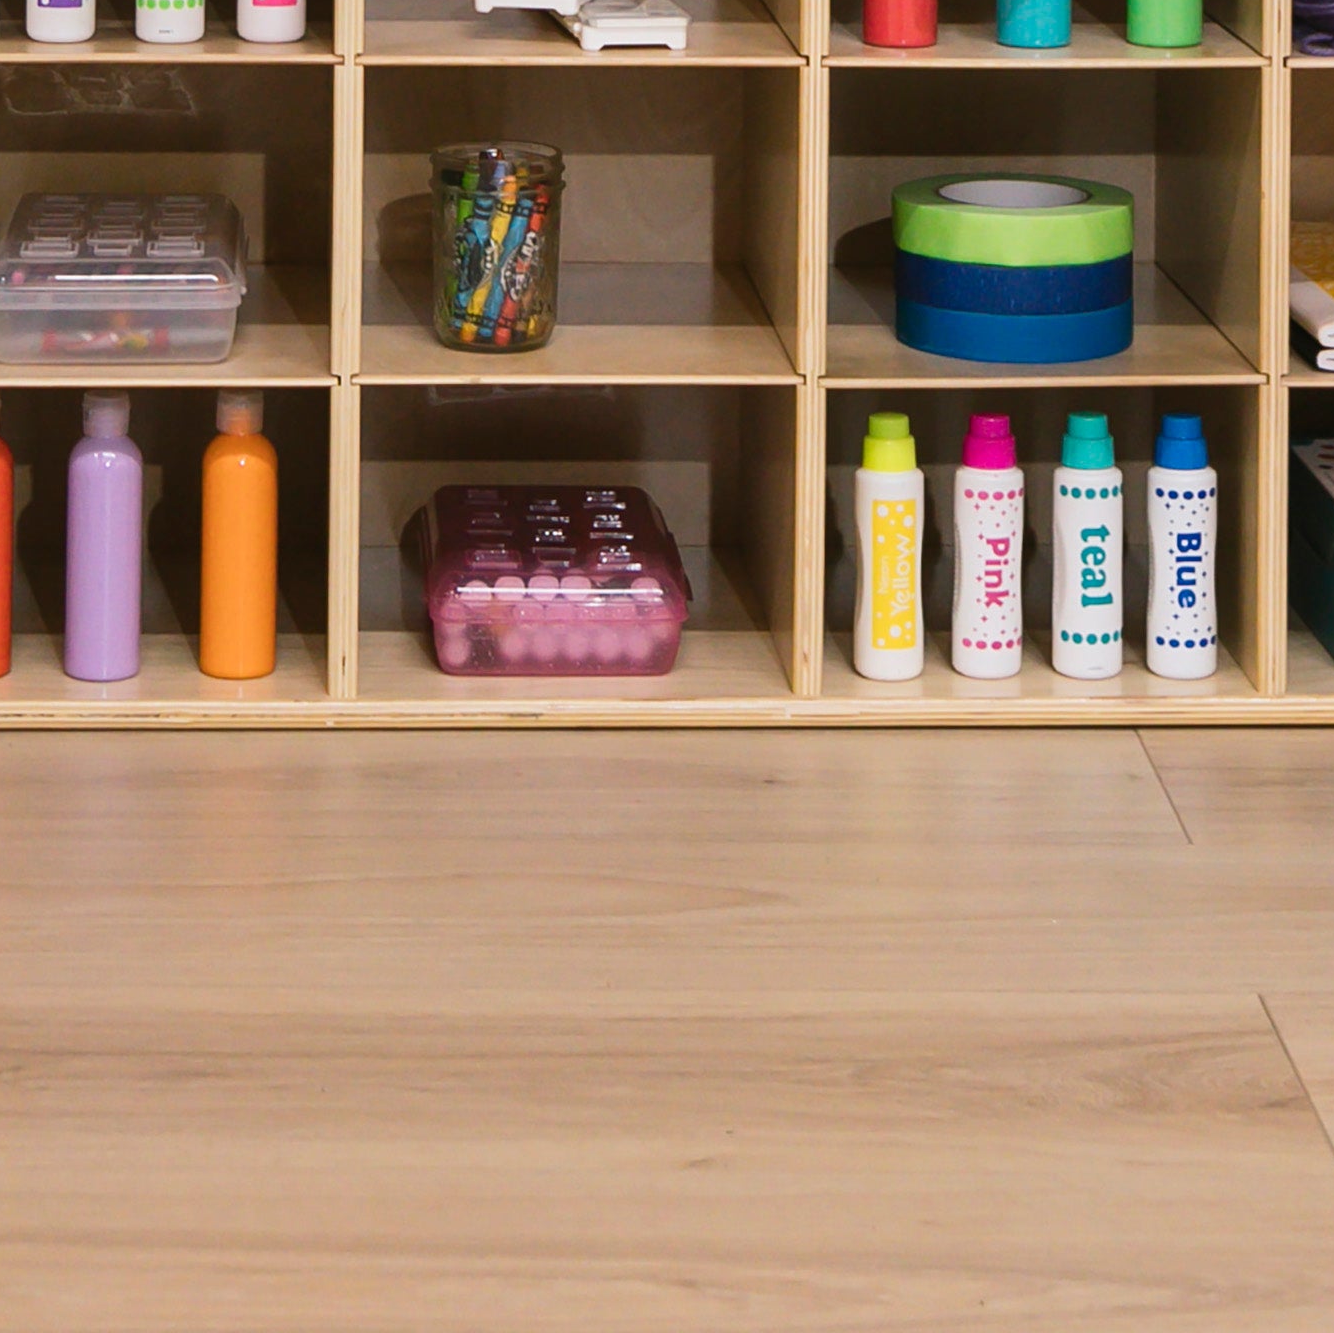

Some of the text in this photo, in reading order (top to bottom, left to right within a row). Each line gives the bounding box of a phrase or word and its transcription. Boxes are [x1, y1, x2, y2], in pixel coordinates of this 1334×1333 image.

[889, 533, 911, 618] Yellow
[984, 537, 1010, 608] Pink
[1080, 524, 1114, 608] teal
[1175, 532, 1203, 609] Blue
